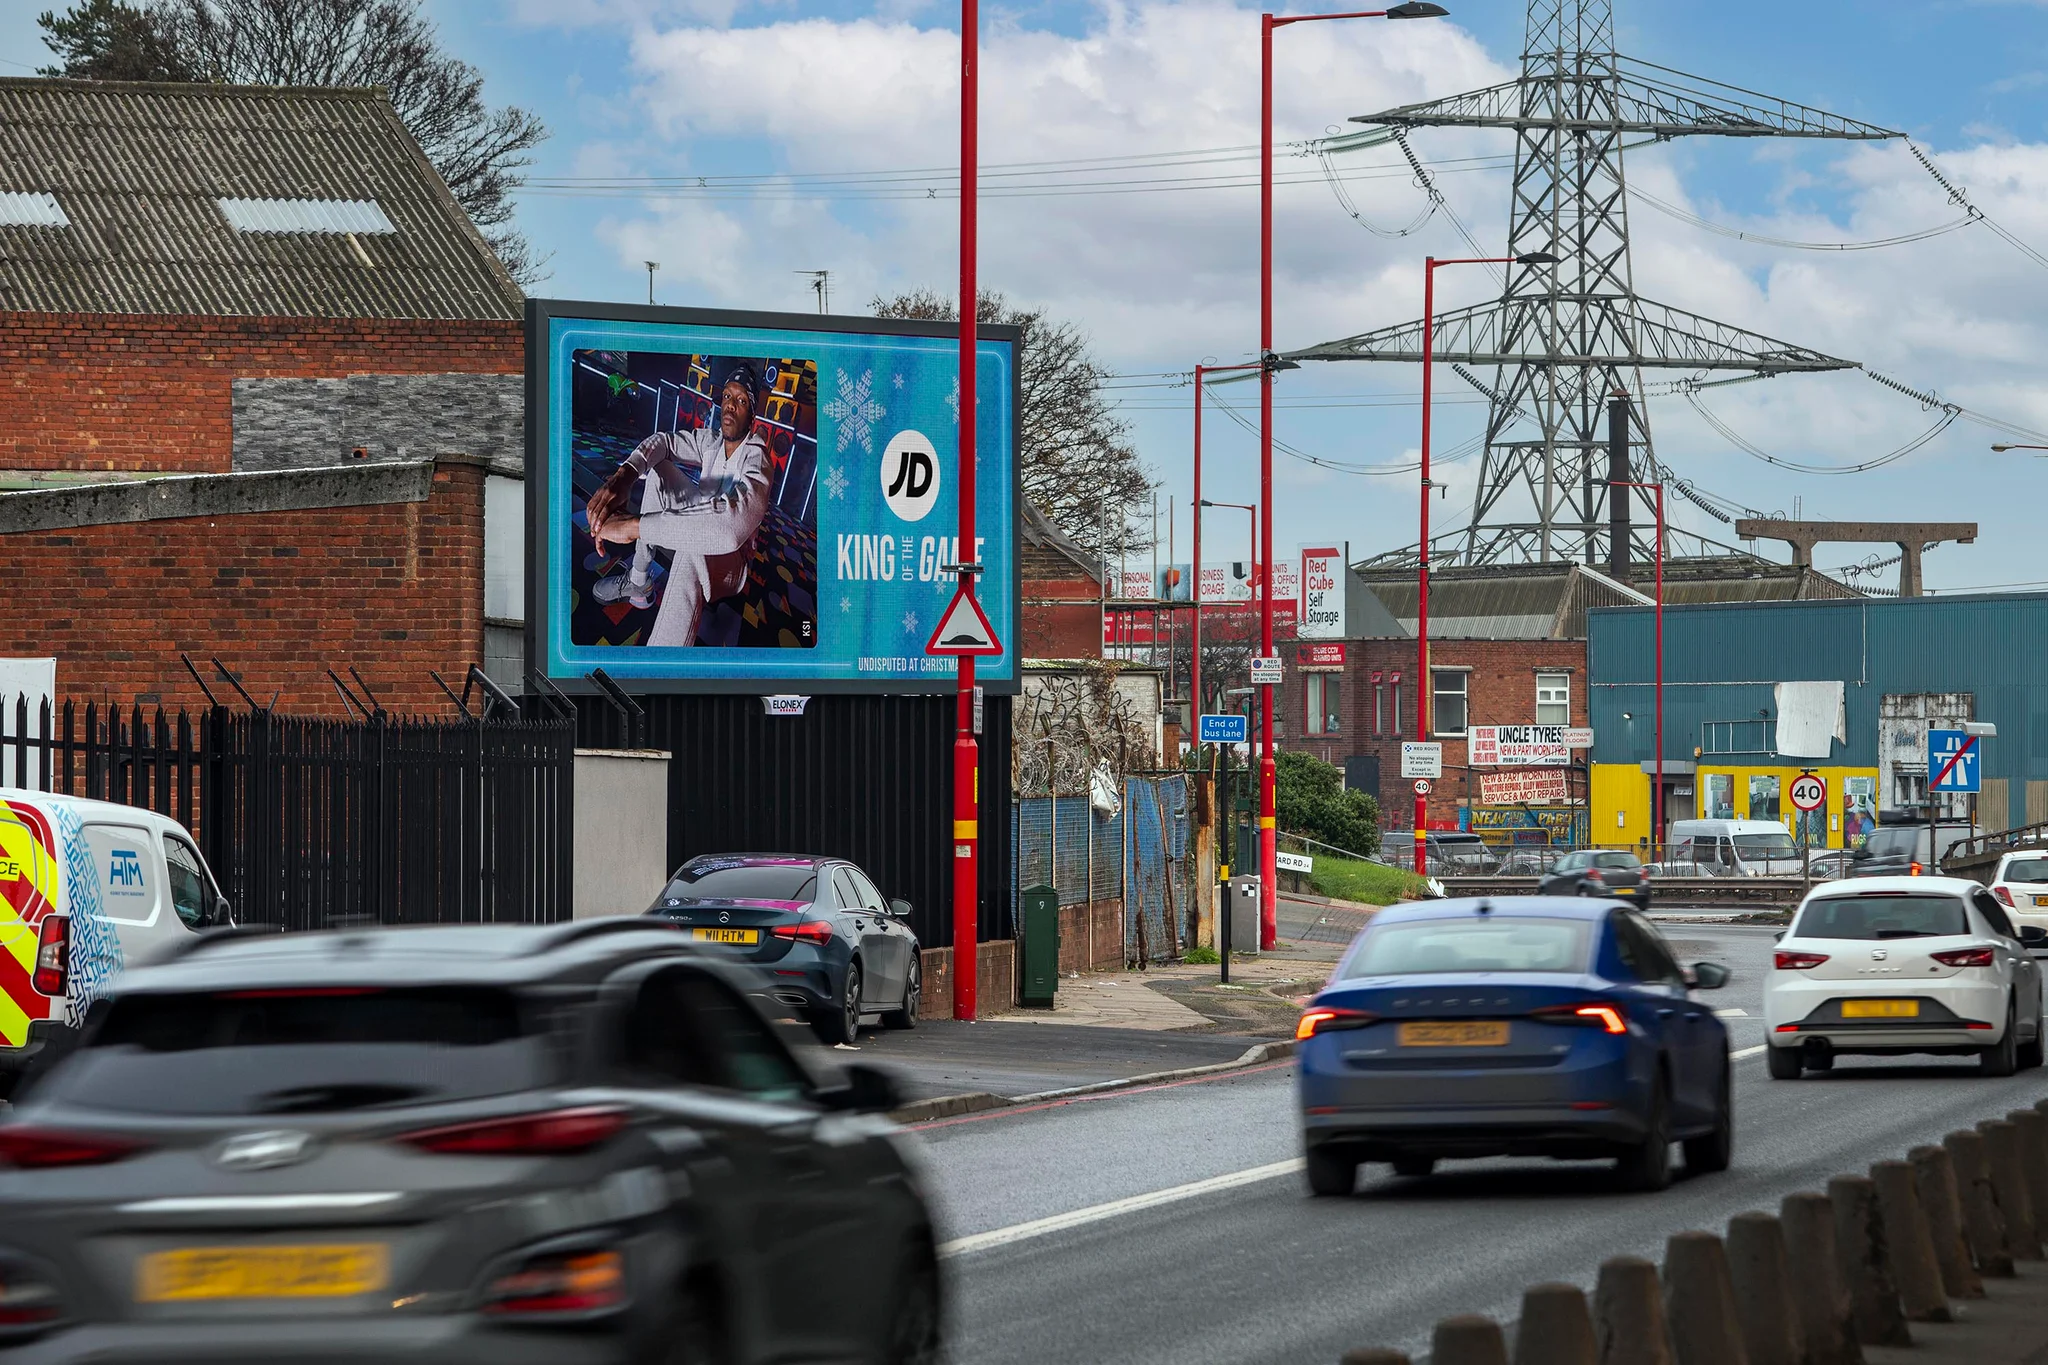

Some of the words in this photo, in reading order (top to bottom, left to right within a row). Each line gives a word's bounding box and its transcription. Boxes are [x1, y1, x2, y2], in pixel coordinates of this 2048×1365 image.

[888, 452, 932, 498] JD
[902, 536, 914, 560] THE
[837, 534, 895, 582] KING
[902, 565, 914, 580] OF
[1309, 559, 1326, 572] Red
[1309, 575, 1334, 590] Cube
[1272, 586, 1289, 595] SPACE
[1309, 592, 1324, 607] Self
[1309, 608, 1338, 626] Storage
[802, 620, 811, 637] KSI
[858, 658, 906, 672] UNDISPUTED
[908, 658, 918, 671] AT
[920, 658, 960, 672] CHRISTMA
[772, 700, 802, 709] ELONEX
[1229, 720, 1238, 728] of
[1204, 729, 1220, 737] bus
[1499, 727, 1529, 743] UNCLE
[1532, 727, 1562, 743] TYRES
[1500, 745, 1512, 756] NEW
[1513, 745, 1517, 755] &
[1517, 745, 1532, 755] PART
[1533, 745, 1550, 755] WORN
[1483, 774, 1496, 783] NEW
[1498, 774, 1502, 782] &
[1504, 773, 1519, 781] PART
[1522, 770, 1542, 780] WORN
[1544, 770, 1562, 779] TYRES
[1484, 792, 1512, 803] SERVICE
[1513, 792, 1518, 800] &
[1520, 791, 1536, 800] MOT
[1538, 789, 1565, 798] REPAIRS
[1794, 785, 1820, 800] 40
[1472, 811, 1506, 824] NEW
[1851, 834, 1866, 844] RUGS
[1276, 856, 1291, 865] ARD
[110, 850, 143, 886] HTM
[1039, 901, 1044, 909] 9
[722, 931, 745, 941] HTM
